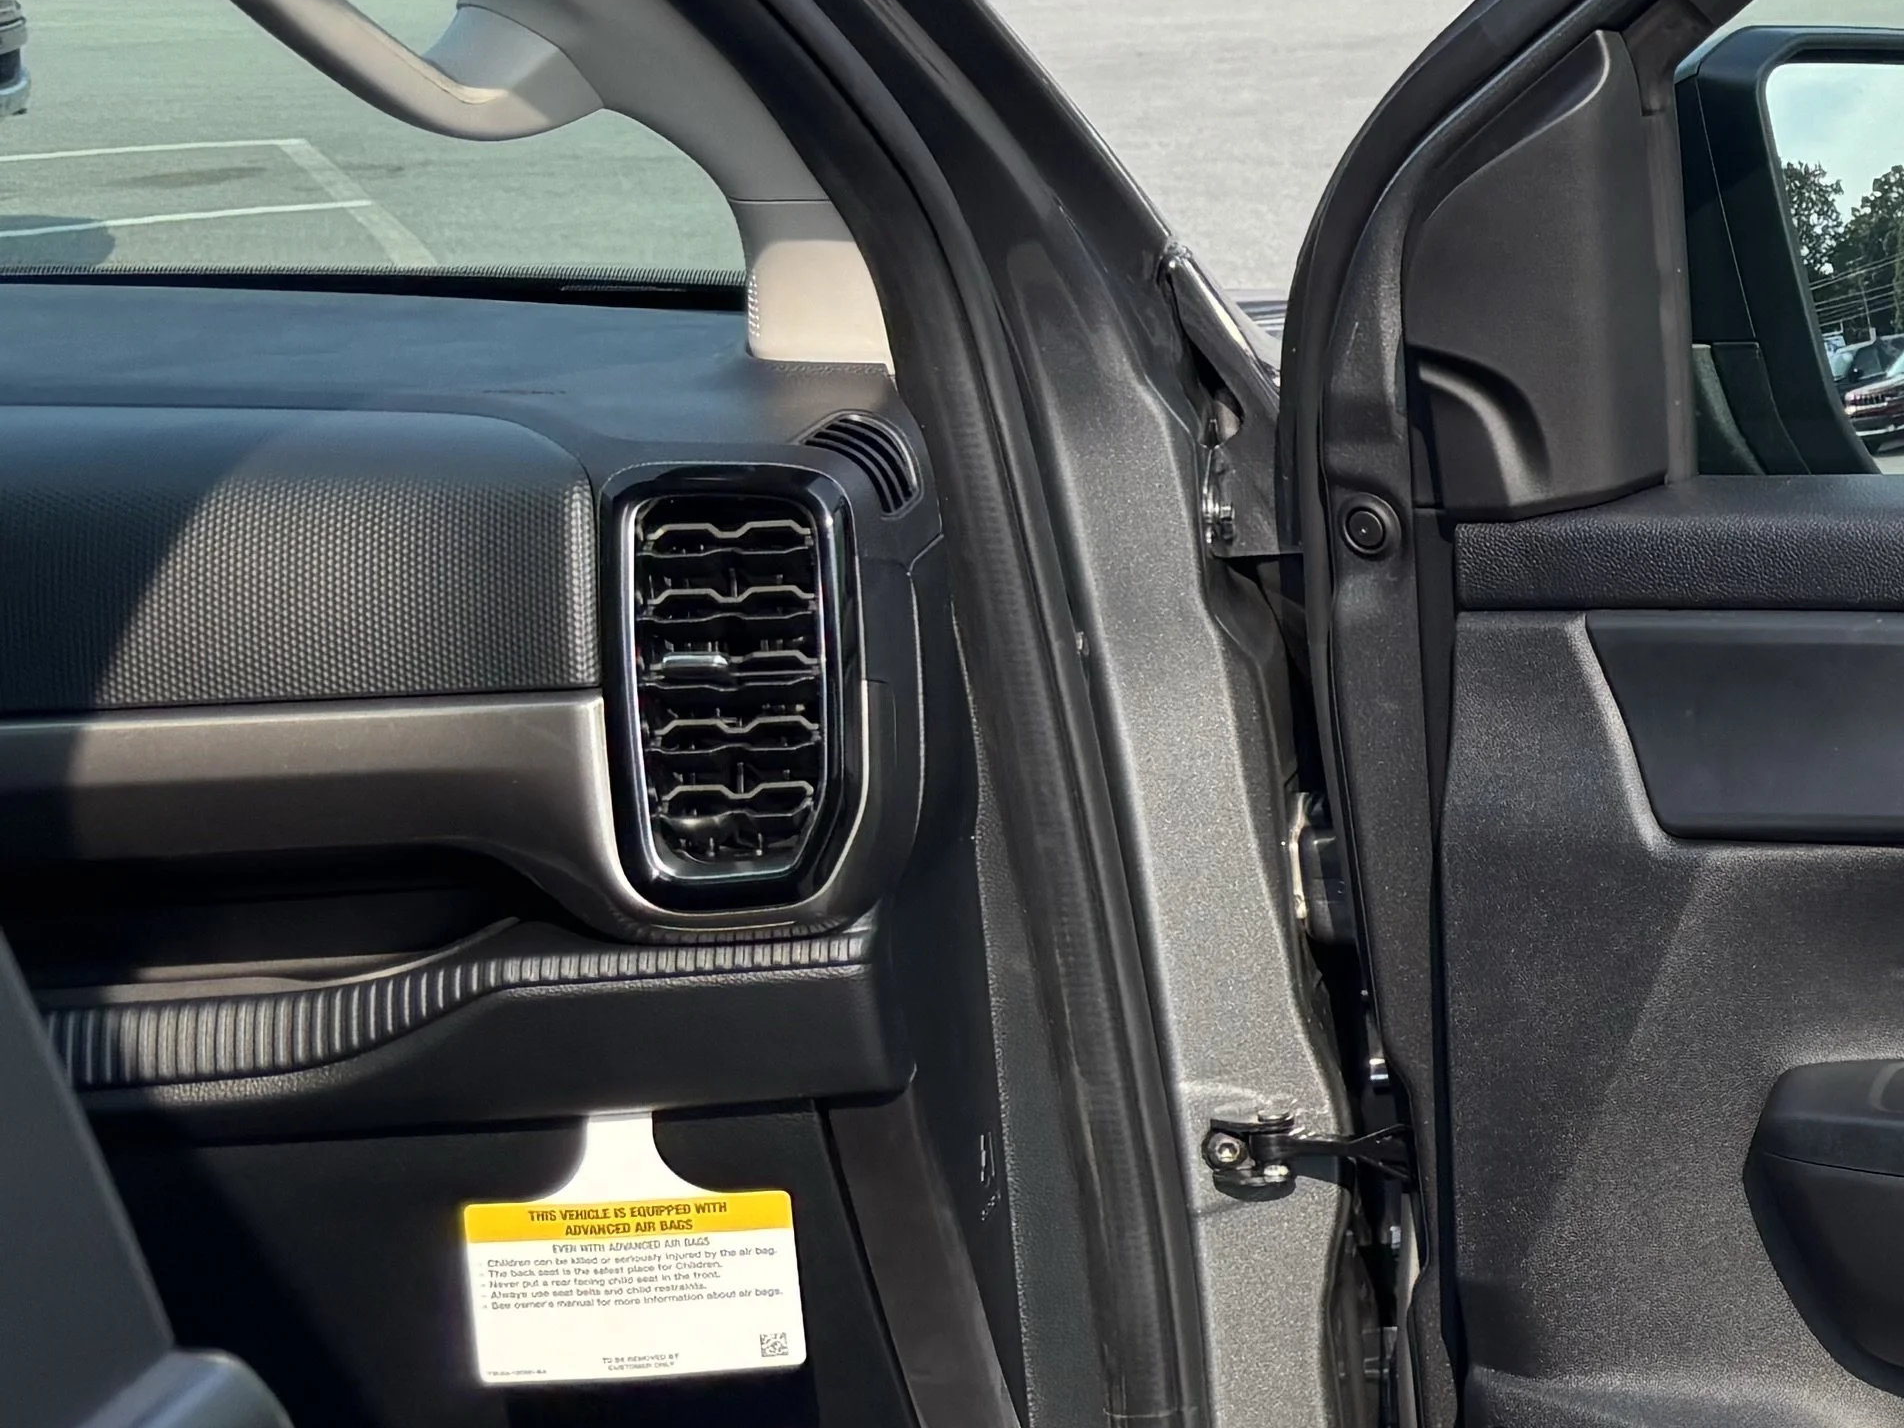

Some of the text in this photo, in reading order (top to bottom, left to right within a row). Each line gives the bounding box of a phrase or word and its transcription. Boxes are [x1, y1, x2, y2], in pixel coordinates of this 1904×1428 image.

[528, 1202, 727, 1221] THIS VEHICLE IS EQUIPPED WITH
[565, 1219, 693, 1236] ADVANCED AIR BAGS
[552, 1237, 710, 1253] EVEN WITH ADVANCED AIR BAGS
[487, 1259, 531, 1267] Children
[555, 1257, 568, 1265] be
[614, 1254, 661, 1263] seriously
[665, 1251, 701, 1261] injured
[704, 1251, 716, 1259] by
[720, 1249, 737, 1257] the
[739, 1247, 752, 1256] air
[755, 1247, 778, 1256] bag.
[488, 1270, 507, 1278] The
[510, 1270, 535, 1278] back
[594, 1266, 623, 1275] safest
[627, 1265, 655, 1274] place
[658, 1263, 672, 1271] for
[489, 1280, 519, 1288] Never
[522, 1280, 539, 1288] put
[574, 1277, 605, 1287] facing
[608, 1276, 633, 1285] child
[637, 1275, 658, 1283] seat
[674, 1272, 690, 1280] the
[491, 1291, 527, 1299] Always
[552, 1289, 573, 1297] seat
[576, 1288, 601, 1296] belts
[604, 1287, 623, 1295] and
[626, 1285, 651, 1294] child
[491, 1301, 511, 1310] See
[556, 1298, 594, 1307] manual
[597, 1298, 611, 1306] for
[614, 1297, 640, 1305] more
[643, 1293, 703, 1304] information
[706, 1290, 736, 1299] about
[739, 1289, 752, 1297] air
